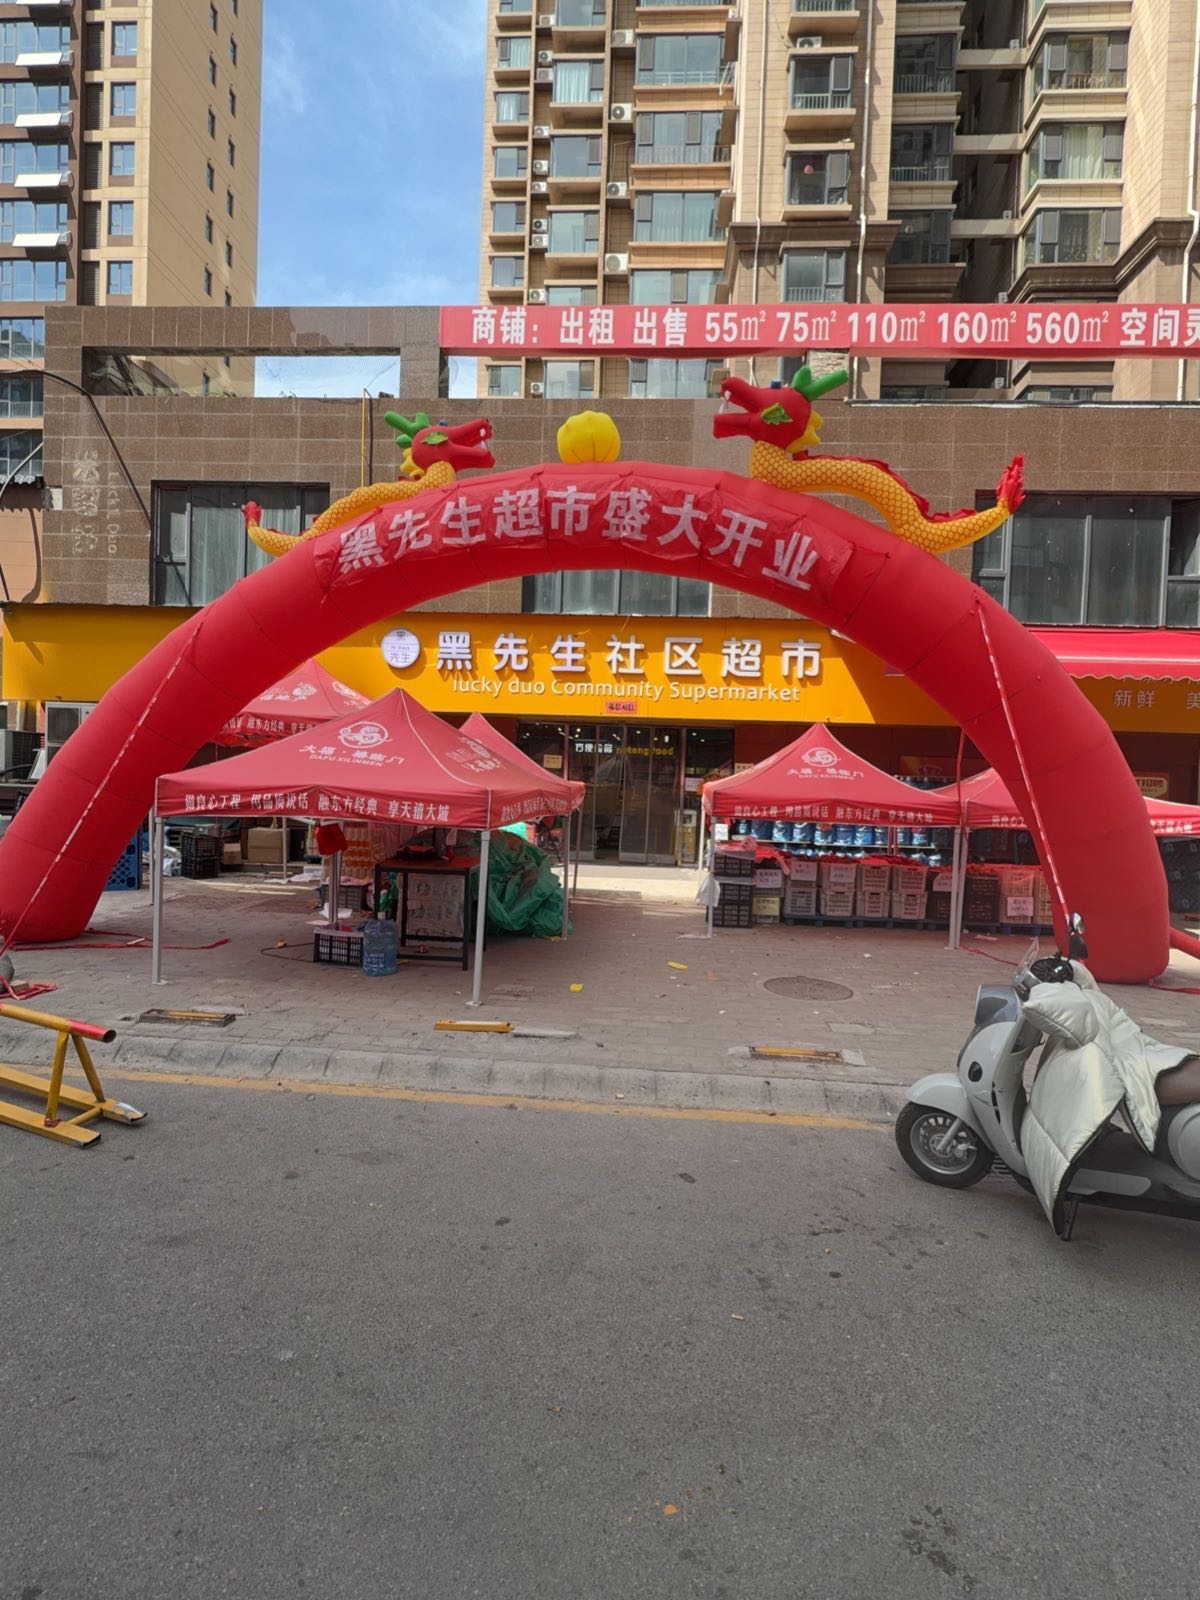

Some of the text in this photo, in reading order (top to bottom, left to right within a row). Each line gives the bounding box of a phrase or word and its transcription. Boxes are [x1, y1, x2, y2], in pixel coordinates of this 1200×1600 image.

[559, 307, 615, 345] 出租
[633, 307, 688, 346] 出售
[338, 484, 822, 592] 黑先生超市盛大开业
[436, 631, 822, 679] 黑先生社区超市
[508, 677, 545, 695] duo
[551, 679, 663, 701] Community
[669, 682, 800, 702] Supermarket
[1113, 690, 1155, 708] 新鲜
